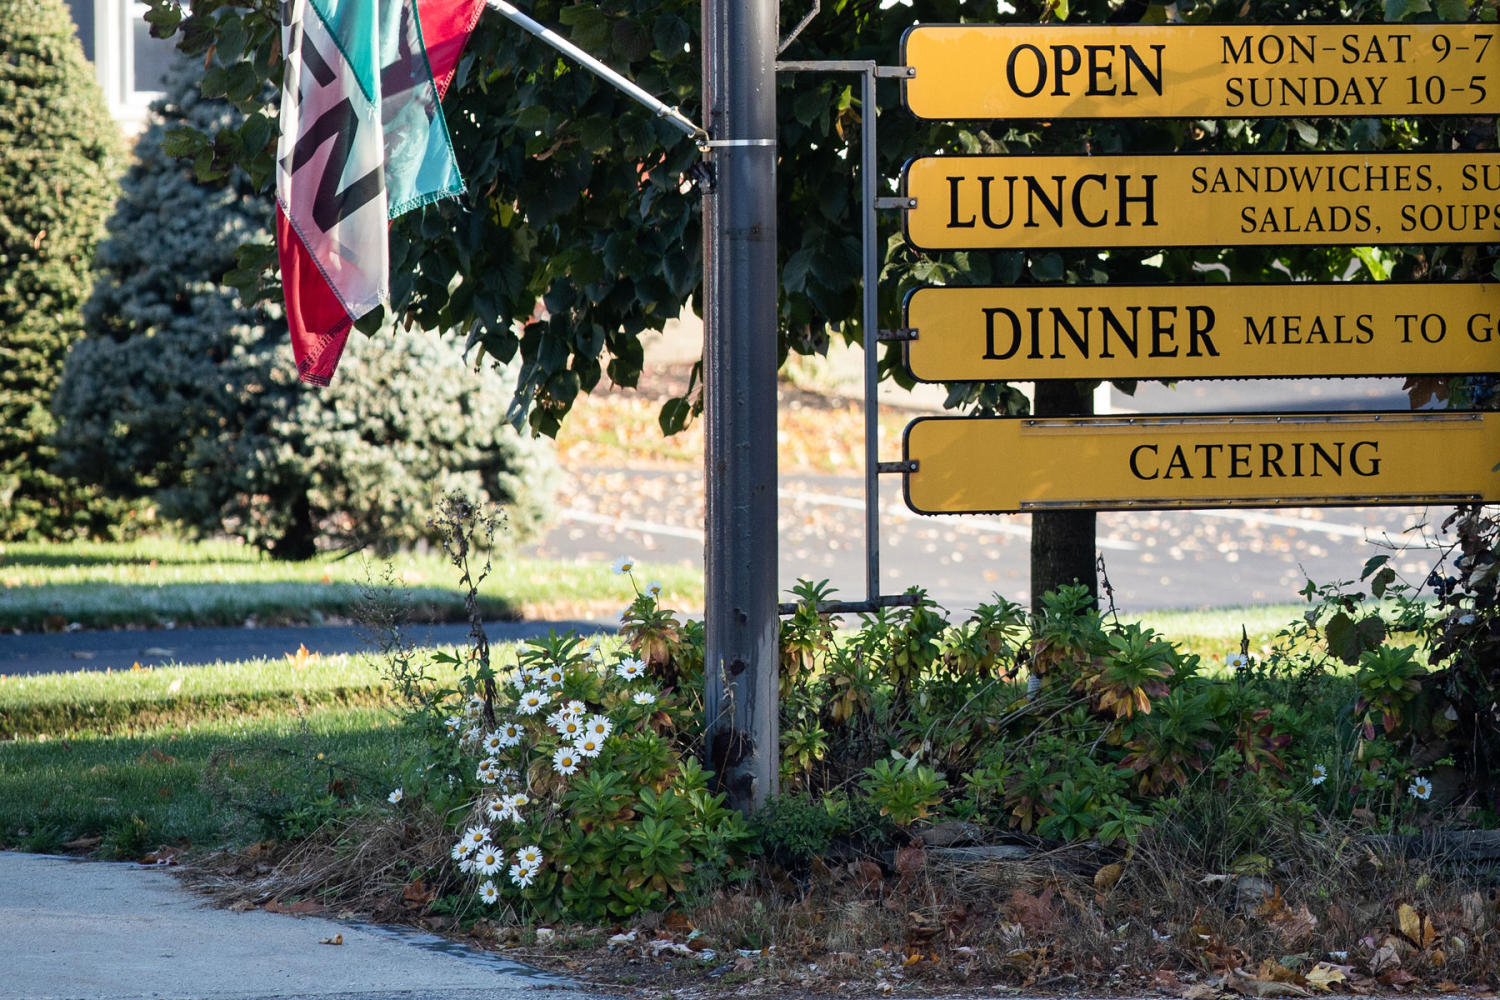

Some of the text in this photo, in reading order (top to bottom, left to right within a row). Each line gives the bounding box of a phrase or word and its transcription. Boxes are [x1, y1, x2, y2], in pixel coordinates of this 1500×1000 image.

[1220, 34, 1494, 65] MON-SAT 9-7
[1006, 43, 1166, 98] OPEN
[1226, 75, 1487, 108] SUNDAY 10-5
[1191, 164, 1442, 194] SANDWICHES,
[945, 173, 1159, 230] LUNCH
[1241, 205, 1381, 234] SALADS,
[981, 305, 1221, 361] DINNER
[1243, 314, 1374, 345] MEALS
[1394, 313, 1447, 344] TO
[1129, 441, 1382, 481] CATERING
